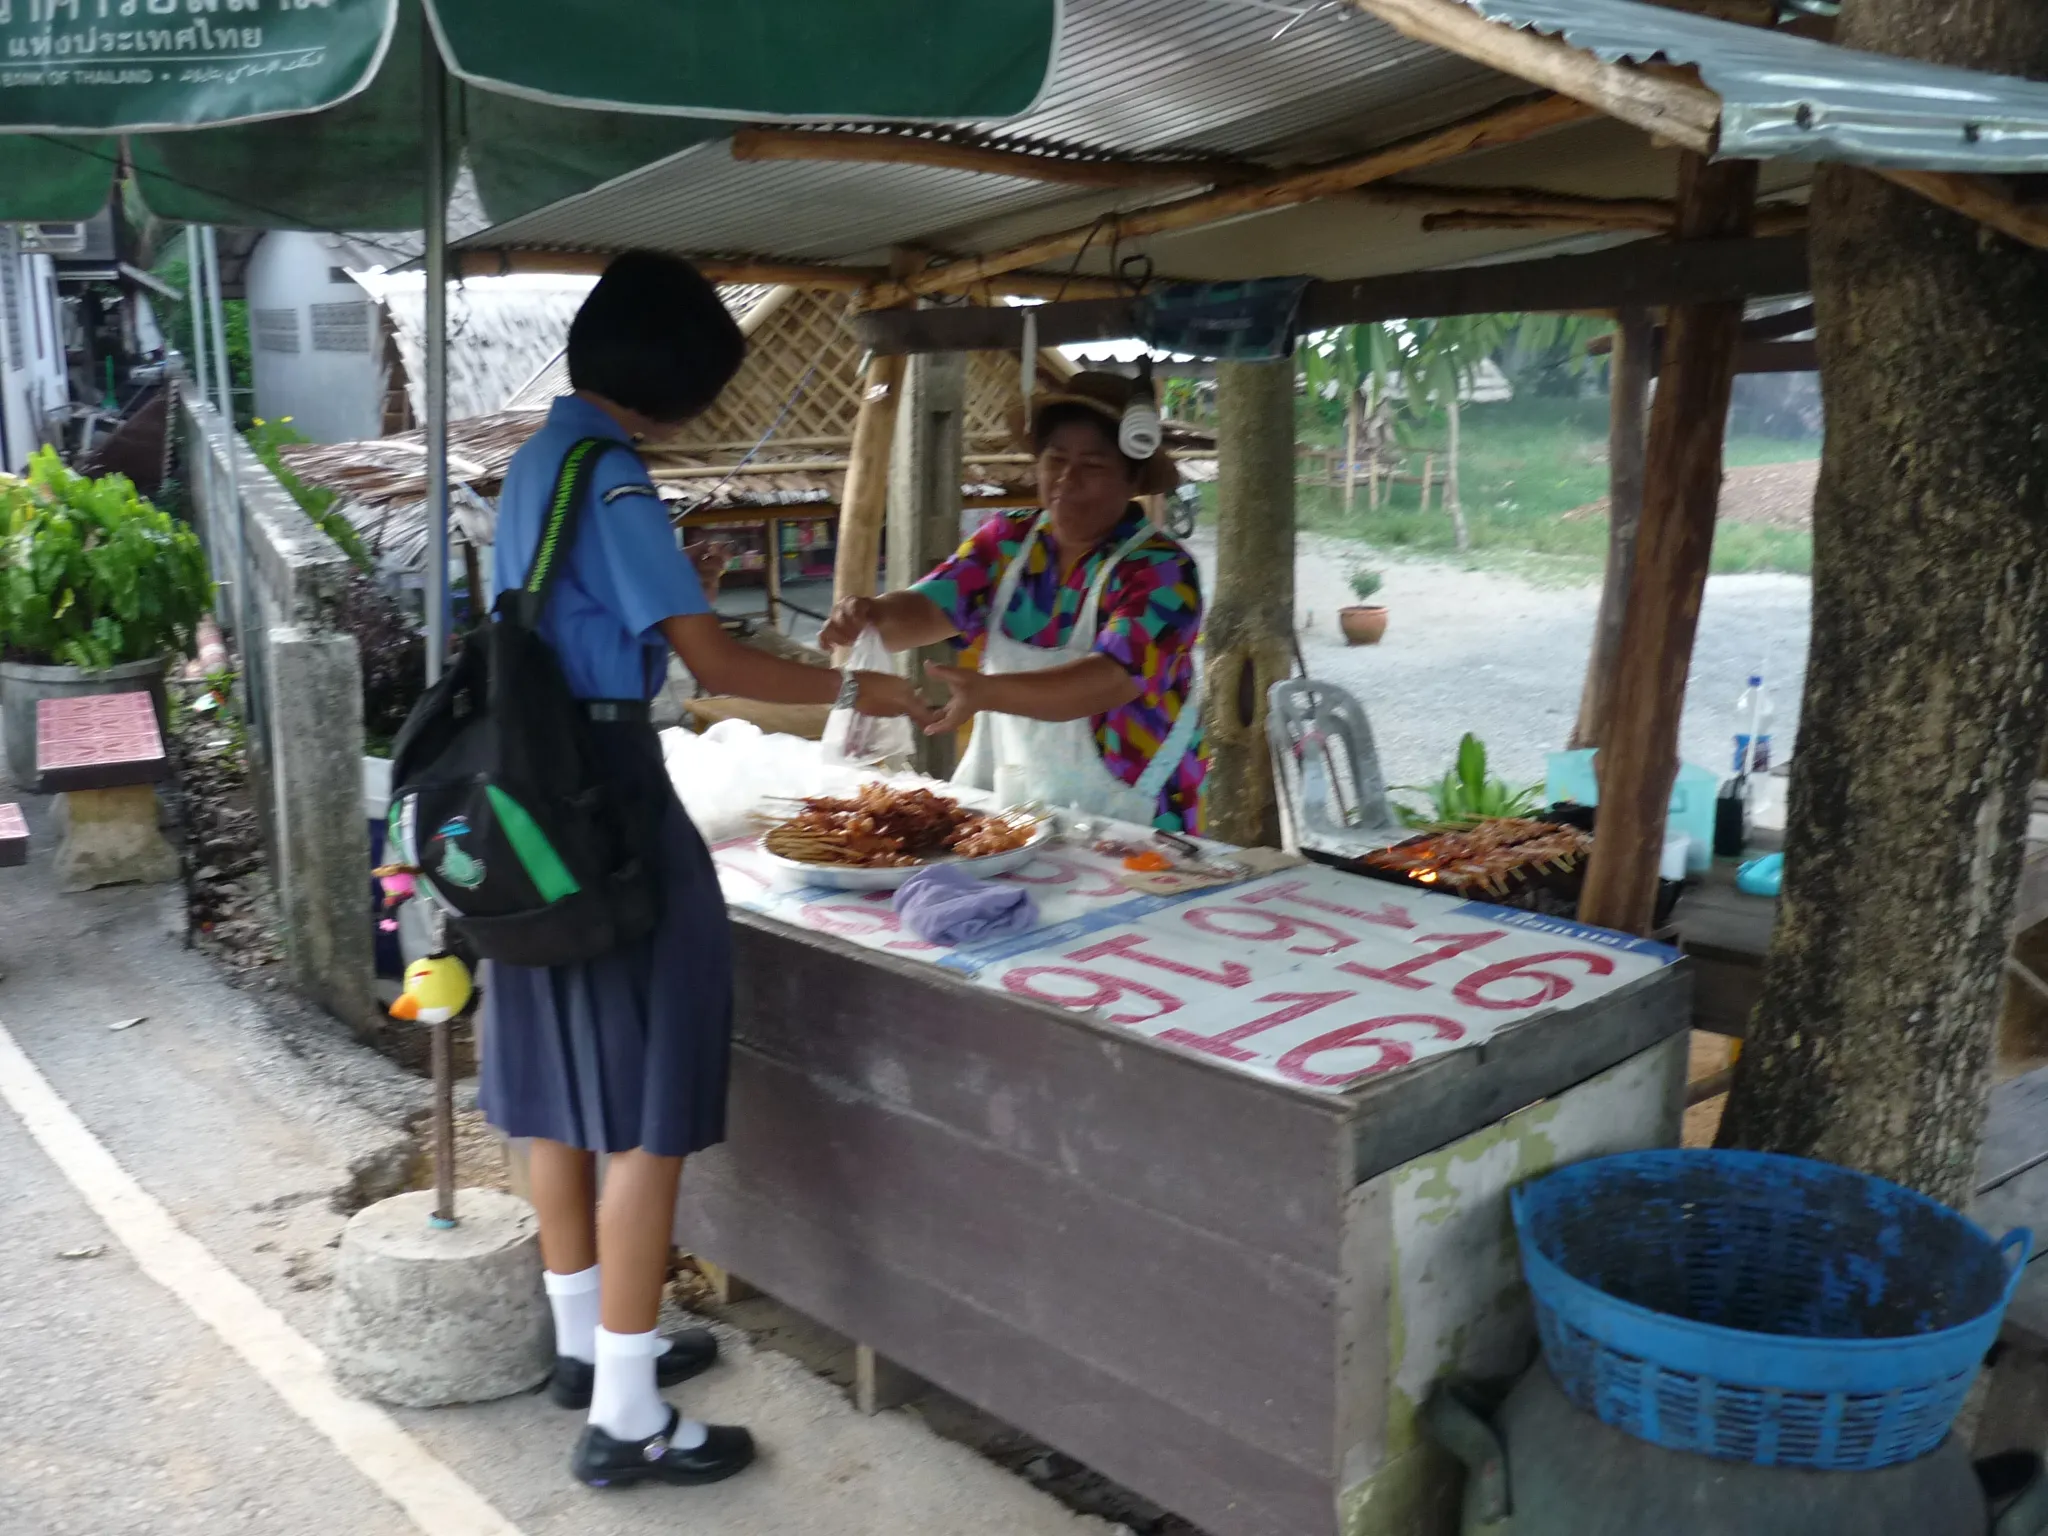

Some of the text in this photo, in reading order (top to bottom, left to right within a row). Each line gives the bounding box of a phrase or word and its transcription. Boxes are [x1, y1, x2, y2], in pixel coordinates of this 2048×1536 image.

[8, 17, 263, 58] แห่งประเทศไทย
[48, 70, 70, 86] OF
[73, 68, 154, 85] THAILAND
[1336, 929, 1617, 1011] 16
[1153, 989, 1467, 1086] 16
